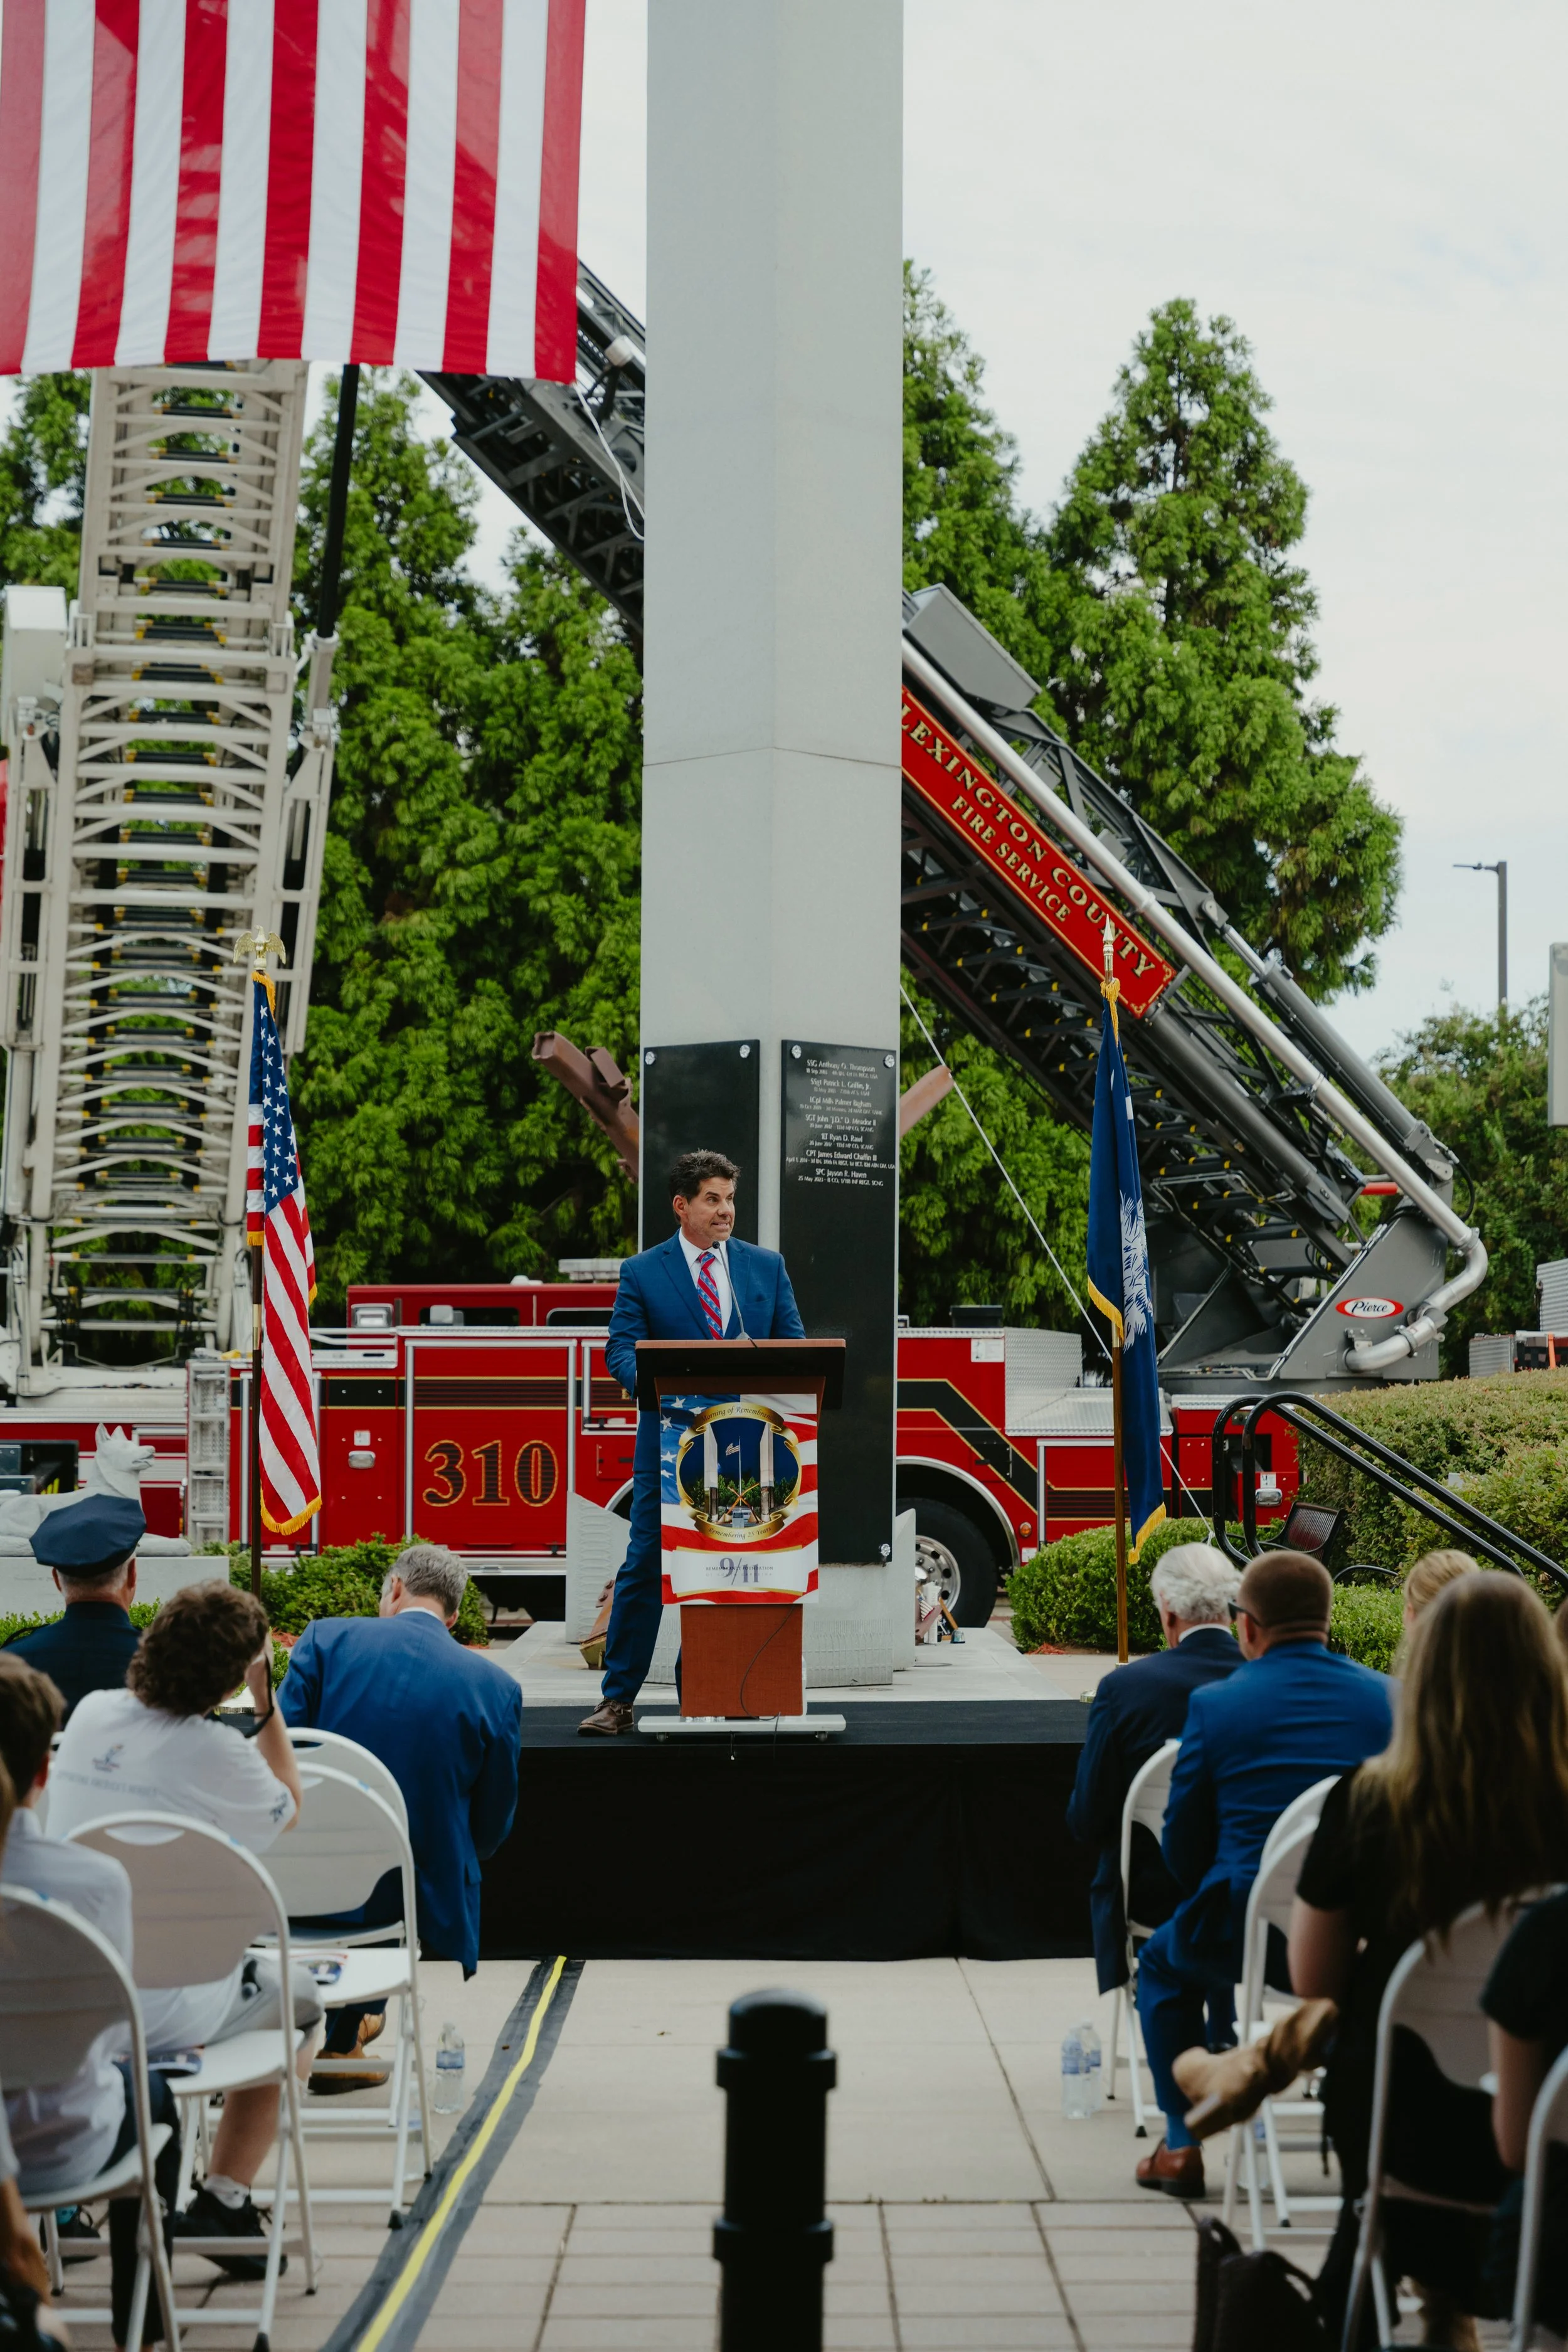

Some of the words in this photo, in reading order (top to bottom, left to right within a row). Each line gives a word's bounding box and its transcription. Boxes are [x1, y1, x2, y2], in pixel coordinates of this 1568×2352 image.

[902, 703, 1047, 862] LEXINGTON
[951, 795, 996, 844] FIRE
[995, 842, 1071, 921] SERVICE
[818, 1061, 840, 1070] Anthony
[849, 1063, 876, 1073] Thompson
[824, 1079, 840, 1087] Patrick
[847, 1081, 864, 1090] Griffin,
[852, 1118, 872, 1126] Meador
[829, 1133, 842, 1142] Ryan
[834, 1152, 852, 1160] Edward
[854, 1153, 871, 1161] Chaffin
[827, 1169, 843, 1177] Jayson
[1352, 1301, 1387, 1313] Pierce
[702, 1409, 726, 1422] Morning
[728, 1406, 734, 1414] of
[422, 1439, 559, 1507] 310
[708, 1527, 746, 1540] Remembering
[756, 1526, 771, 1536] Years
[719, 1557, 759, 1586] 9/11
